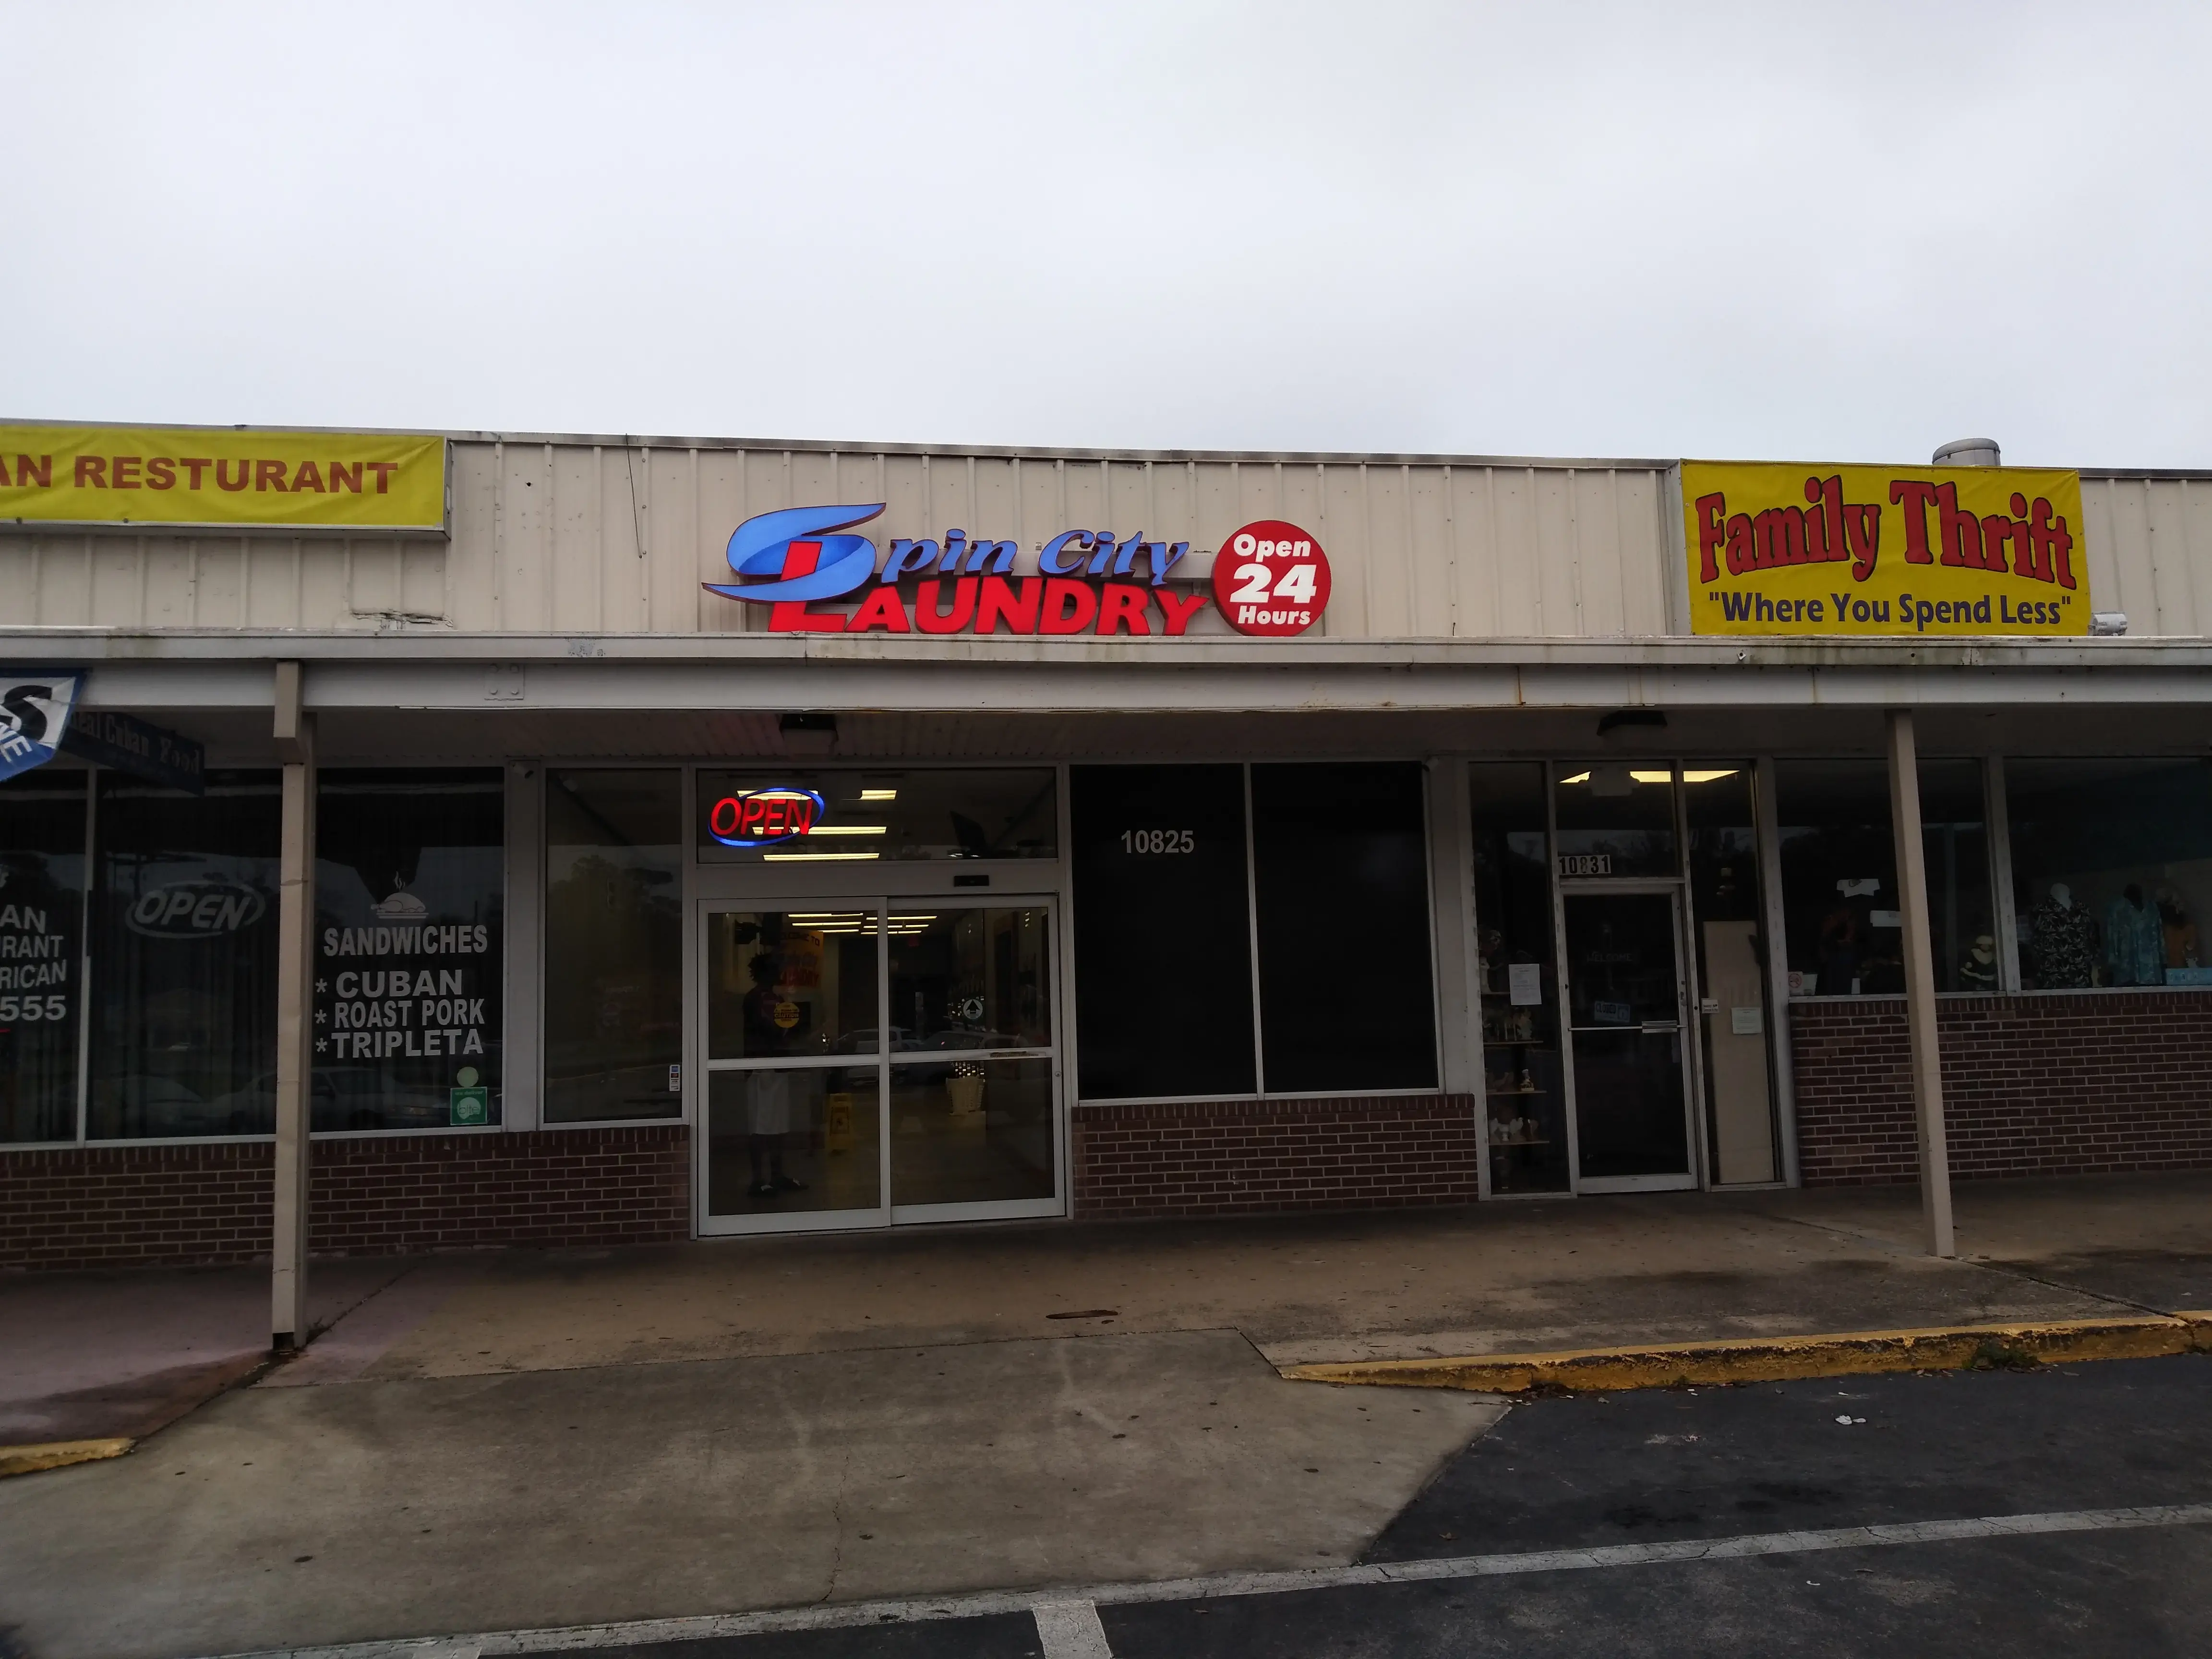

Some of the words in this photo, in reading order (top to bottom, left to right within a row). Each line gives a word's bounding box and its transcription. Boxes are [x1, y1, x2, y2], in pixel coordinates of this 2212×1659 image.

[74, 455, 398, 494] RESTURANT
[1234, 533, 1311, 562] Open
[1695, 474, 1881, 583] Family
[1889, 481, 2077, 590] Thrift
[1039, 529, 1190, 587] City
[768, 541, 1210, 636] LAUNDRY
[1229, 563, 1317, 603] 24
[1238, 605, 1311, 625] Hours
[1709, 592, 1824, 623] "Where
[1831, 593, 1889, 623] You
[1899, 593, 1991, 632] Spend
[2000, 595, 2071, 625] Less"
[709, 796, 813, 836] OPEN
[1121, 830, 1195, 854] 10825
[1560, 856, 1608, 874] 10831
[134, 890, 252, 931] OPEN
[0, 936, 64, 958] RANT
[323, 925, 488, 956] SANDWICHES
[336, 969, 463, 998] CUBAN
[334, 1000, 412, 1028] ROAST
[422, 998, 485, 1026] PORK
[331, 1028, 484, 1058] TRIPLETA
